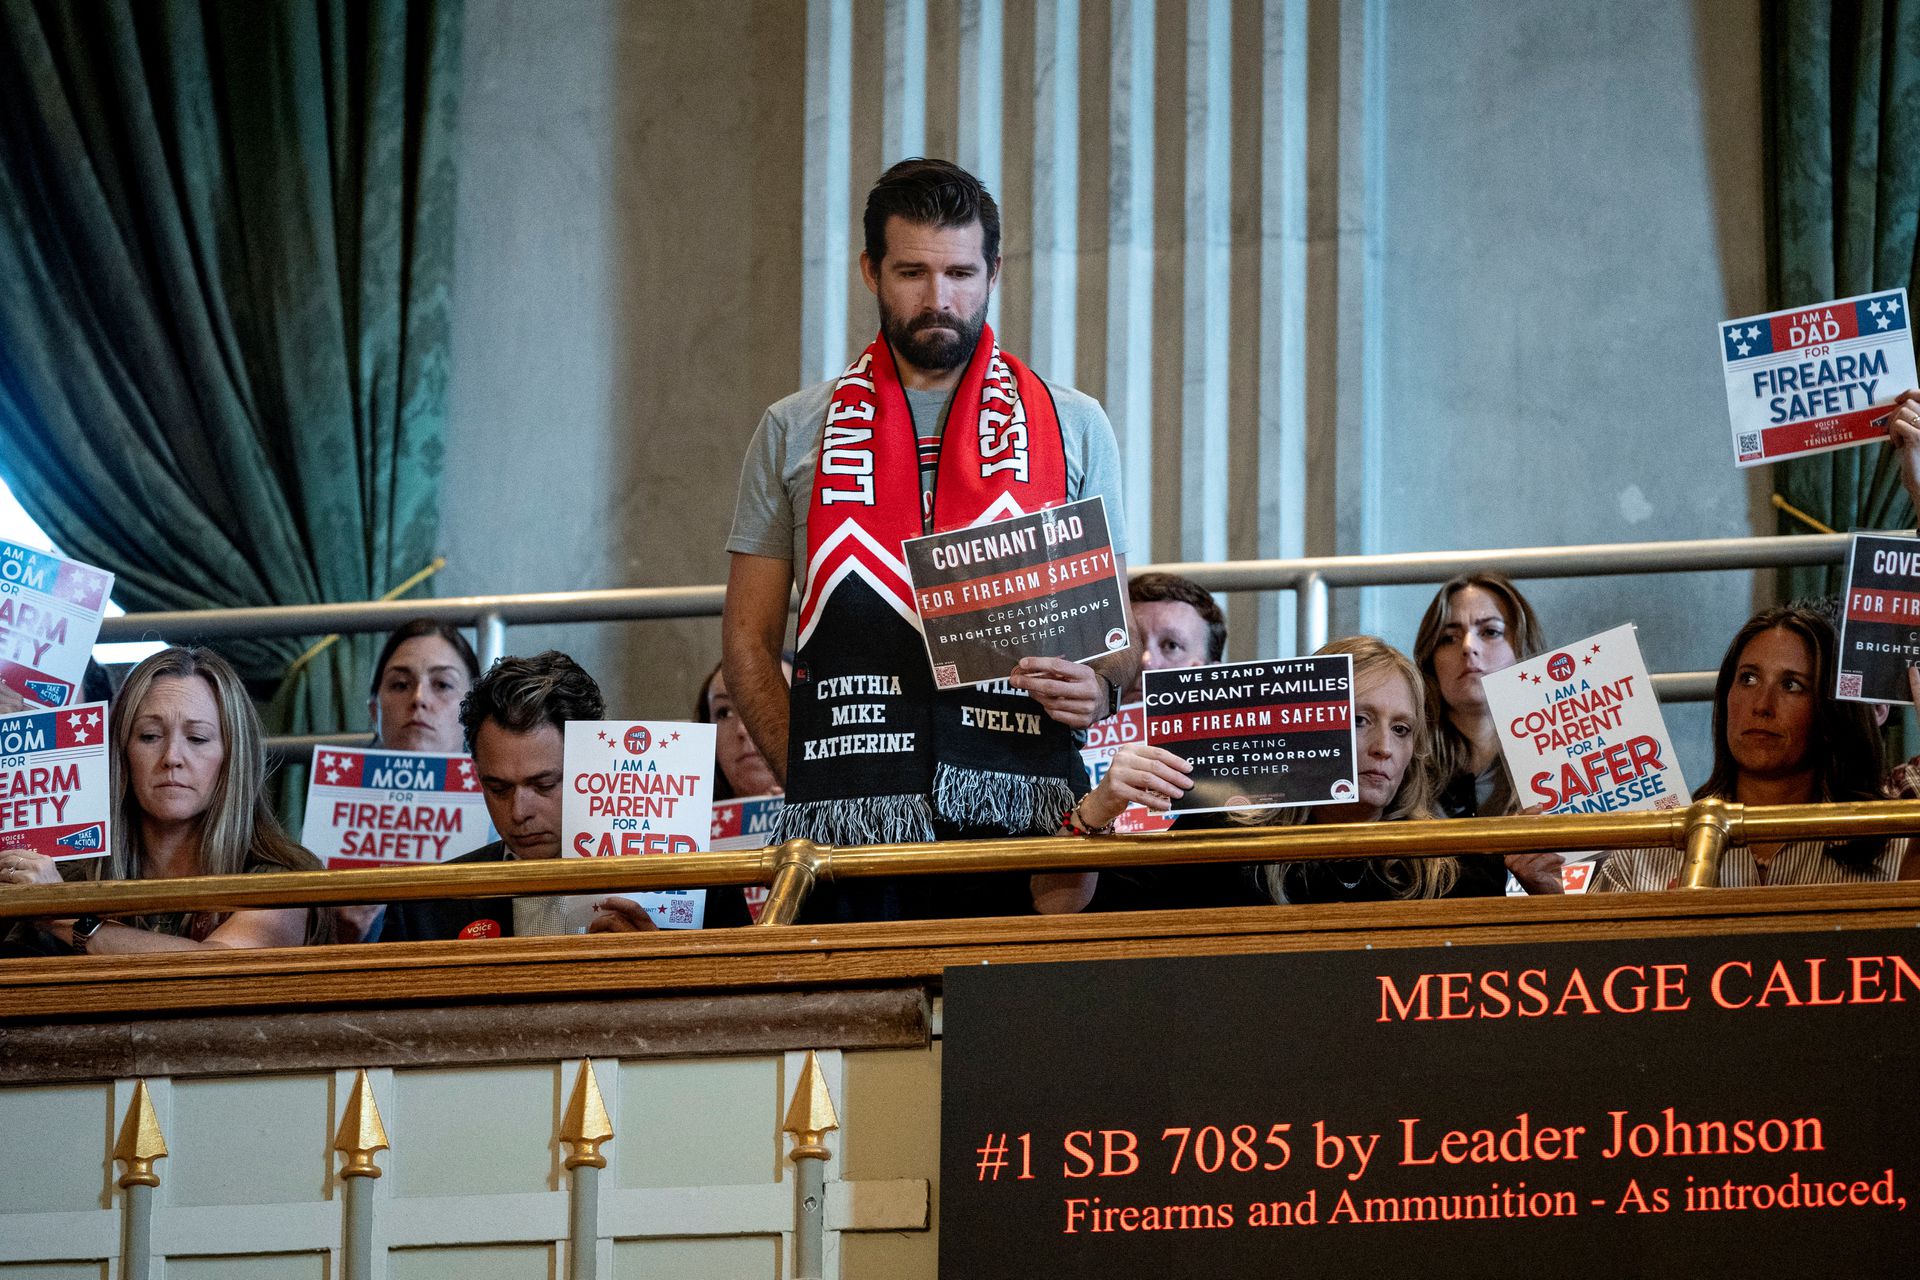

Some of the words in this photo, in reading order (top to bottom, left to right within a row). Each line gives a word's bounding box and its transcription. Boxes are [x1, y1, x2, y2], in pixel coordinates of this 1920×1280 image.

[1792, 316, 1797, 326] I
[1801, 312, 1821, 325] AM
[1824, 310, 1834, 320] A
[1789, 320, 1841, 347] DAD
[1805, 346, 1830, 359] FOR
[1753, 349, 1889, 398] FIREARM
[1770, 379, 1879, 423] SAFETY
[1805, 432, 1853, 447] TENNESSEE
[821, 400, 877, 506] LOVE
[932, 527, 1037, 571] COVENANT
[1042, 515, 1084, 546] DAD
[3, 547, 23, 561] AM
[29, 555, 36, 566] A
[0, 558, 44, 590] OM
[922, 591, 954, 610] FOR
[962, 572, 1041, 602] FIREARM
[1048, 552, 1110, 584] SAFETY
[0, 583, 19, 597] OR
[987, 599, 1059, 623] CREATING
[1853, 594, 1883, 612] FOR
[940, 619, 1012, 644] BRIGHTER
[1018, 598, 1110, 630] TOMORROWS
[991, 625, 1066, 649] TOGETHER
[1856, 641, 1920, 655] BRIGHTE
[1179, 673, 1203, 683] WE
[1210, 667, 1265, 680] STAND
[1273, 663, 1315, 674] WITH
[1552, 665, 1571, 679] TN
[40, 690, 61, 704] ACTION
[46, 684, 60, 694] TAKE
[817, 675, 902, 700] CYNTHIA
[1147, 685, 1254, 707] COVENANT
[1260, 677, 1349, 696] FAMILIES
[1545, 693, 1551, 704] I
[1555, 686, 1577, 701] AM
[1581, 679, 1591, 692] A
[831, 704, 886, 727] MIKE
[1122, 712, 1131, 722] A
[1510, 675, 1634, 738] COVENANT
[1, 720, 20, 733] AM
[26, 719, 33, 729] A
[961, 705, 1041, 735] EVELYN
[1151, 717, 1183, 737] FOR
[1192, 710, 1271, 731] FIREARM
[1281, 705, 1349, 724] SAFETY
[1533, 704, 1624, 756] PARENT
[628, 740, 646, 751] TN
[804, 732, 915, 761] KATHERINE
[1087, 723, 1138, 747] DAD
[1212, 739, 1286, 751] CREATING
[1187, 754, 1236, 765] GHTER
[1242, 748, 1341, 762] TOMORROWS
[1566, 740, 1592, 759] FOR
[1597, 735, 1606, 749] A
[1, 756, 25, 768] FOR
[385, 757, 389, 768] I
[393, 758, 413, 769] AM
[417, 759, 426, 769] A
[613, 760, 617, 771] I
[621, 760, 643, 771] AM
[647, 760, 657, 772] A
[1211, 764, 1289, 777] TOGETHER
[1530, 734, 1668, 812] SAFER
[0, 763, 81, 798] EARM
[371, 769, 435, 790] MOM
[574, 773, 700, 796] COVENANT
[389, 792, 413, 802] FOR
[589, 796, 679, 819] PARENT
[0, 794, 70, 830] FETY
[332, 801, 462, 833] FIREARM
[748, 813, 779, 833] MO
[78, 830, 92, 839] TAKE
[612, 819, 637, 830] FOR
[642, 819, 650, 830] A
[74, 837, 96, 847] ACTION
[340, 831, 449, 860] SAFETY
[467, 923, 492, 934] VOICE
[1376, 964, 1691, 1022] MESSAGE
[976, 1133, 1035, 1181] #1
[1064, 1129, 1139, 1179] SB
[1161, 1123, 1292, 1175] 7085
[1312, 1120, 1381, 1181] by
[1399, 1113, 1586, 1166] Leader
[1602, 1107, 1825, 1159] Johnson
[1064, 1197, 1234, 1234] Firearms
[1248, 1189, 1317, 1227] and
[1327, 1182, 1578, 1225] Ammunition
[1616, 1178, 1670, 1214] As
[1685, 1169, 1907, 1213] introduced,
